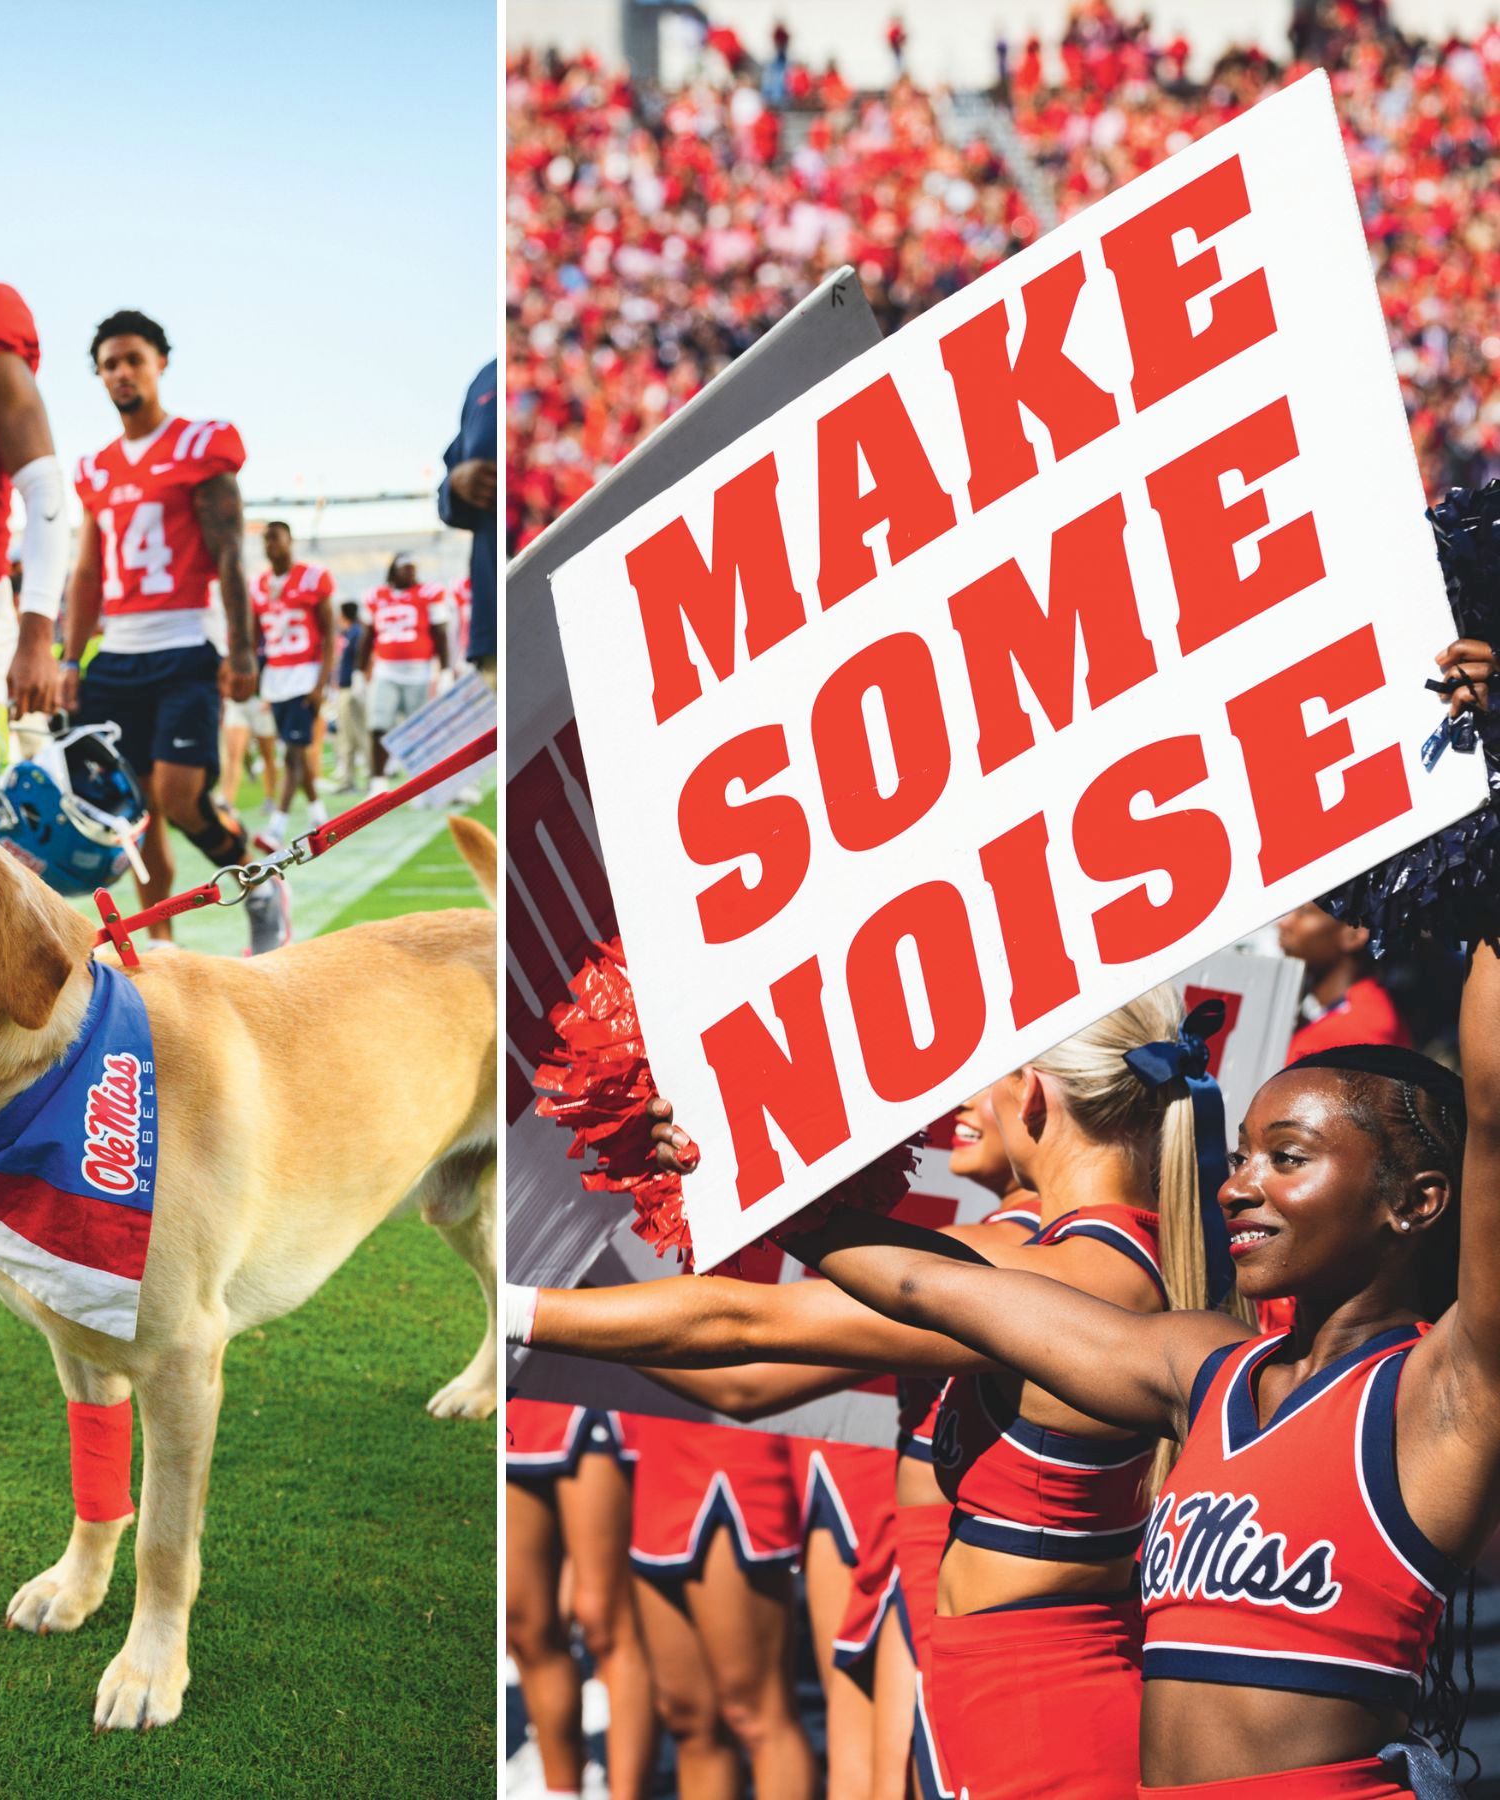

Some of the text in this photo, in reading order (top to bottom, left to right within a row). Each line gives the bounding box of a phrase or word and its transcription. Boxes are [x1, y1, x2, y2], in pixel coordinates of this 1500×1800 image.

[625, 154, 1277, 725] MAKE
[97, 501, 175, 600] 14
[677, 396, 1326, 944] SOME
[700, 624, 1413, 1210] NOISE
[82, 1053, 141, 1194] Ole Miss
[139, 1060, 154, 1193] REBELS
[1140, 1490, 1342, 1614] le Miss
